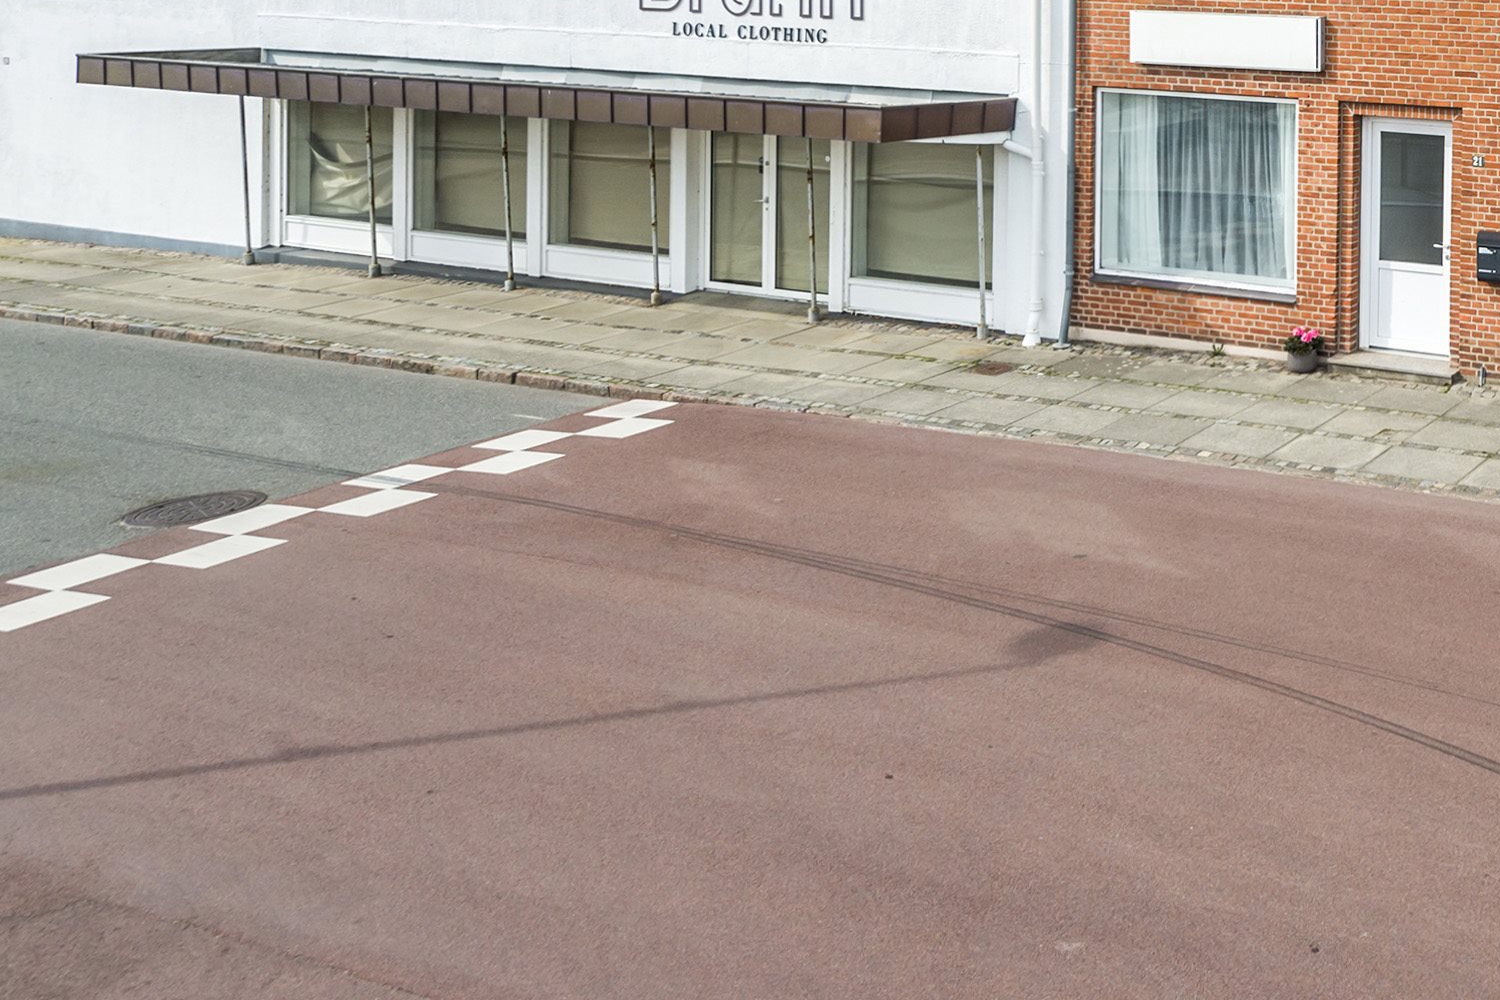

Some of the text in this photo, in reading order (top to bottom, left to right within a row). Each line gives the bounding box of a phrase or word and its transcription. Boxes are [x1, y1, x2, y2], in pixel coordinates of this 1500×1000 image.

[672, 22, 828, 43] LOCAL CLOTHING
[1472, 156, 1483, 167] 21
